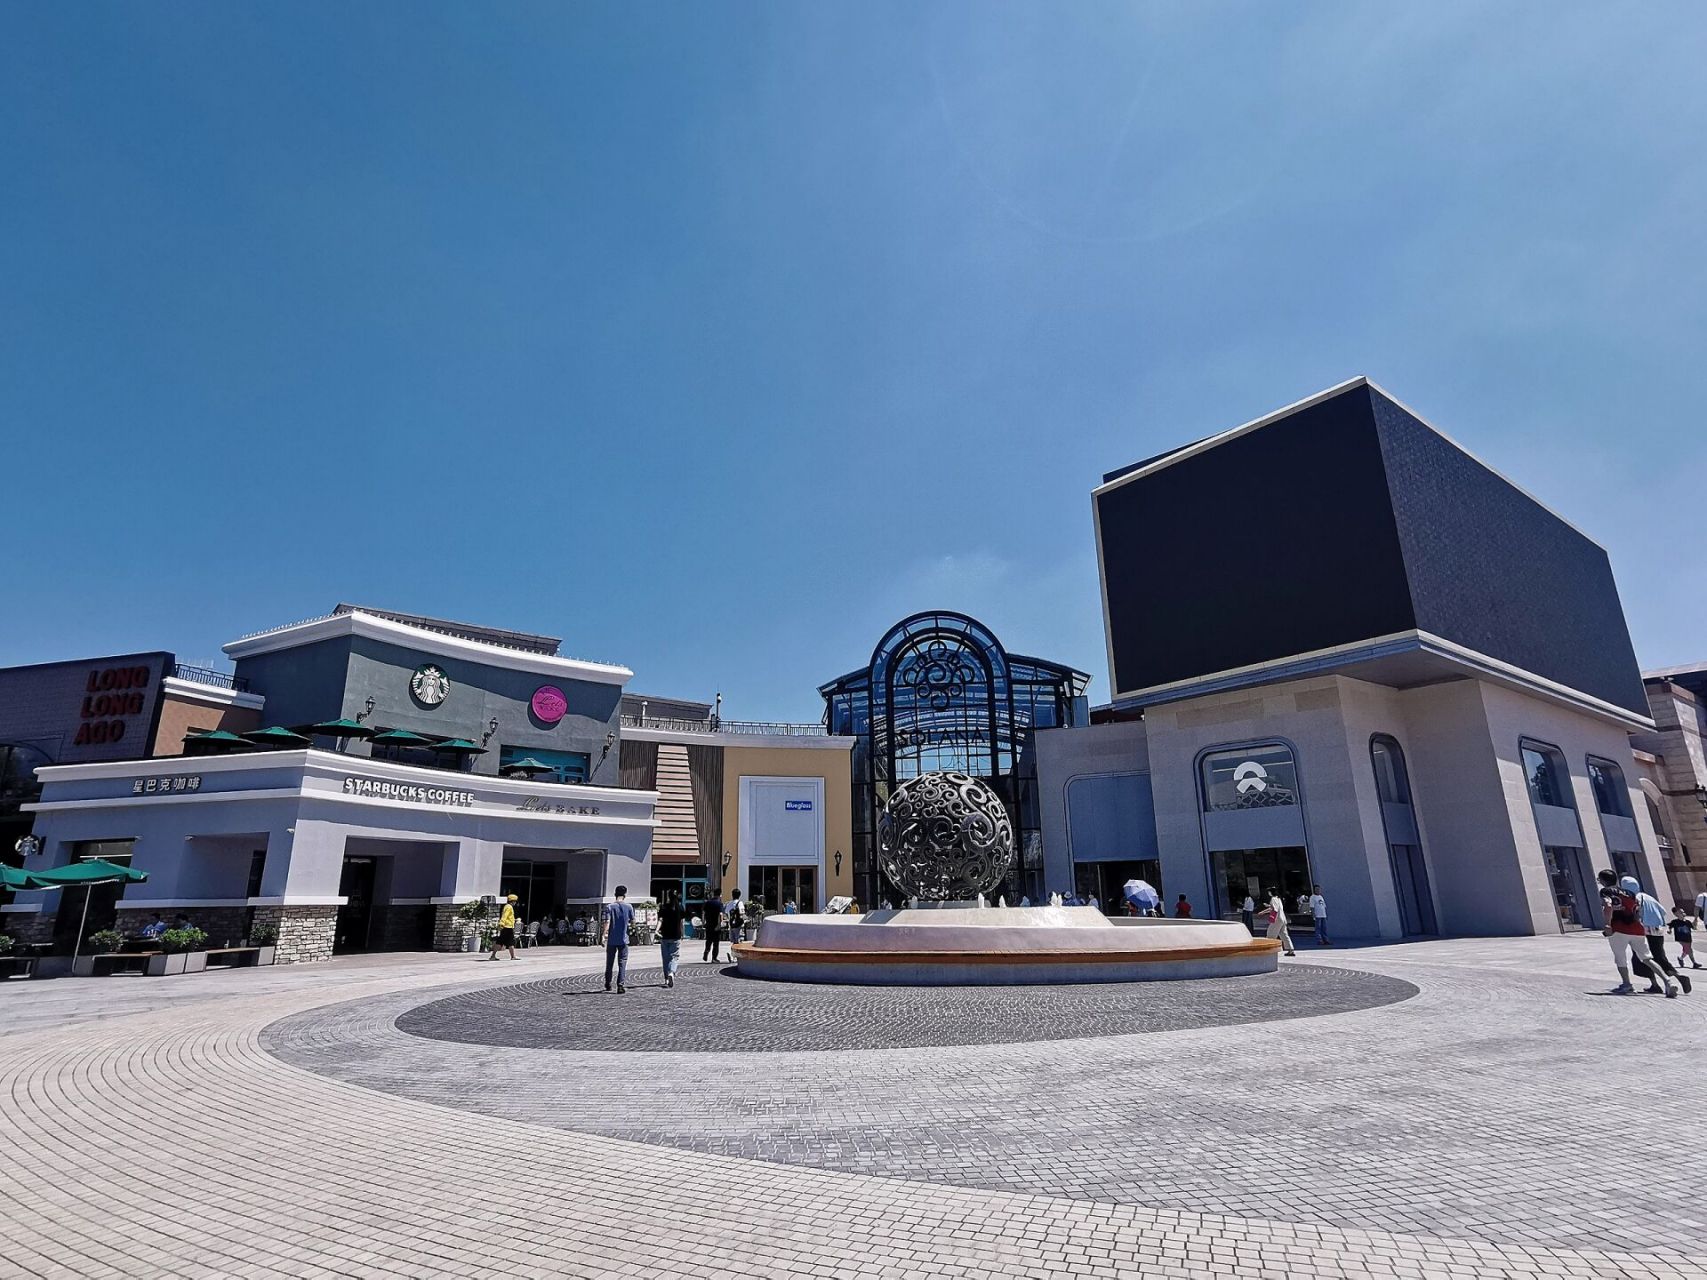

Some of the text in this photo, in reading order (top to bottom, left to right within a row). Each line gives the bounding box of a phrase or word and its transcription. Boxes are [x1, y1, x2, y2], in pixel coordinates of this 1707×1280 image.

[86, 666, 150, 692] LONG
[80, 693, 144, 719] LONG
[73, 720, 126, 745] AGO
[894, 727, 986, 747] SOLANA
[132, 777, 200, 793] 星巴克咖啡
[345, 778, 475, 804] STARBUCKS COFFEE
[554, 804, 601, 816] BAKE
